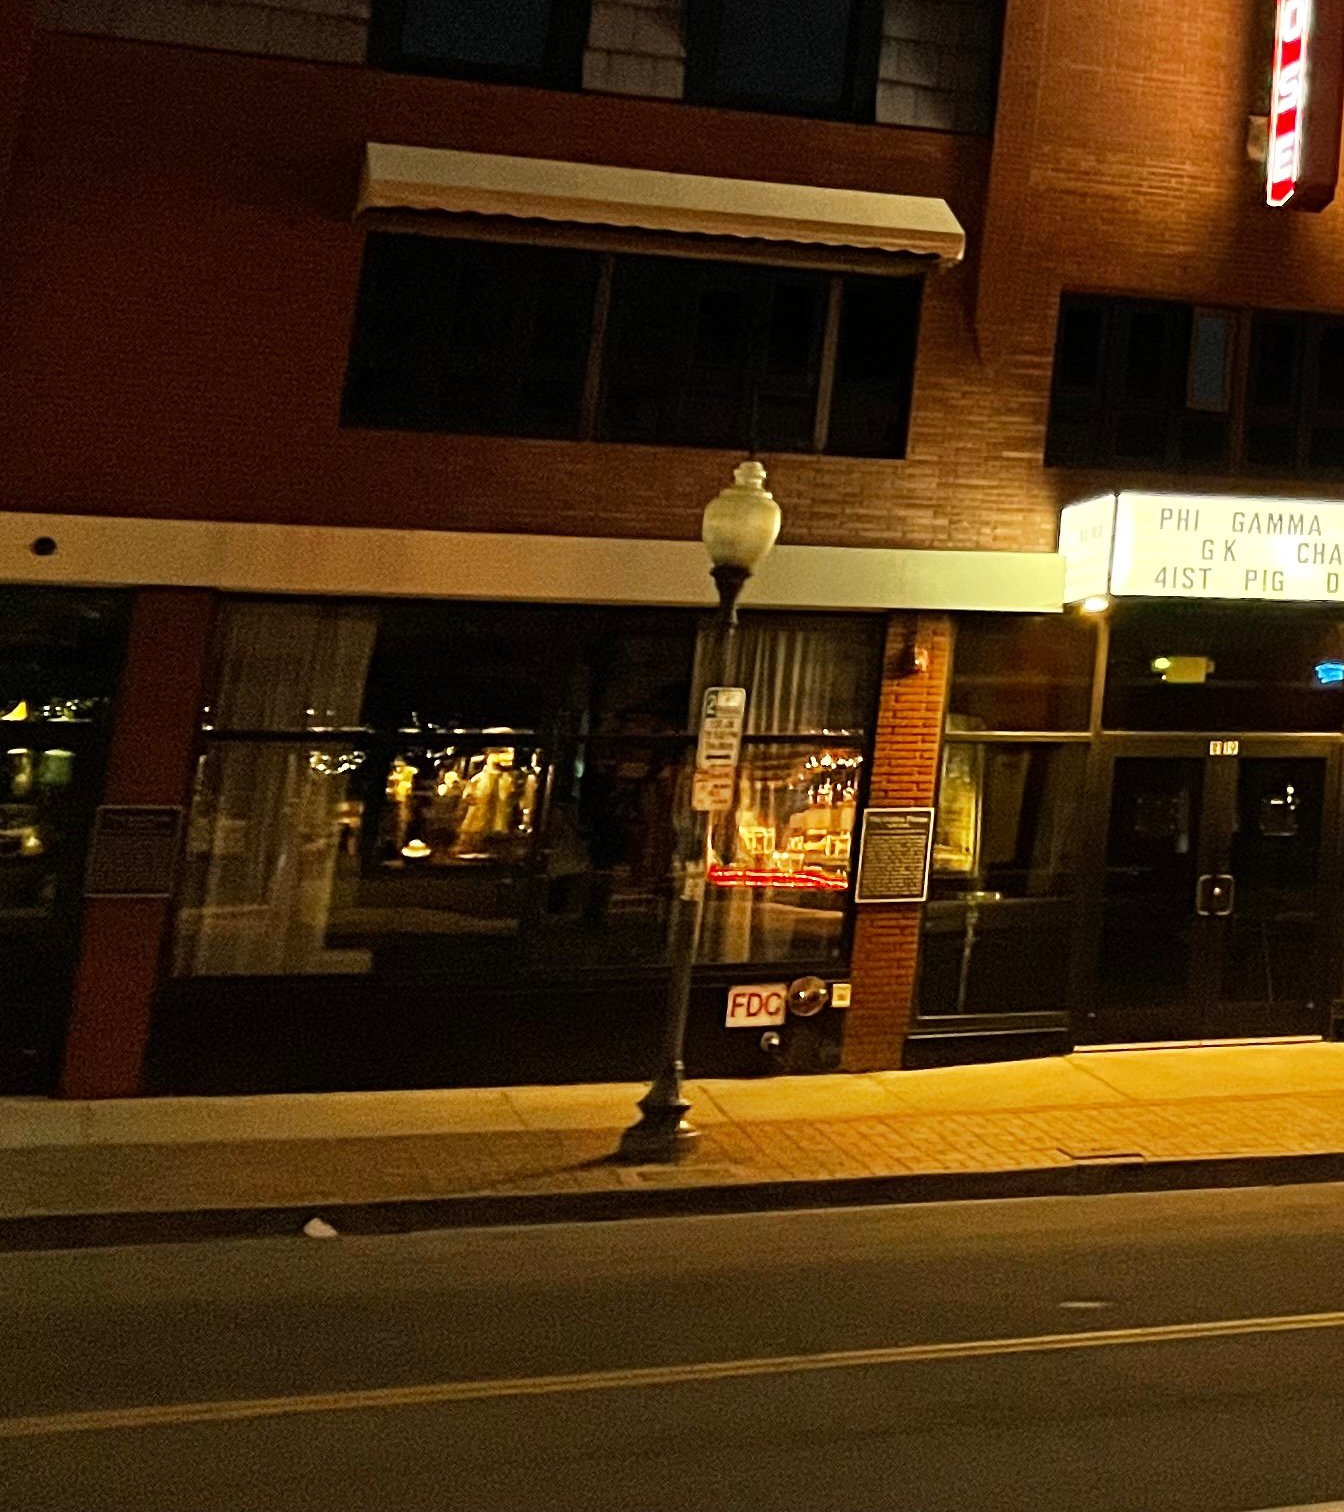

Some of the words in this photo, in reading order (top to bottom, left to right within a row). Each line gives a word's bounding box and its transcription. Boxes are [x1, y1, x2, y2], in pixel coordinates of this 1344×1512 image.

[1159, 507, 1200, 532] PHI
[1231, 511, 1322, 537] GAMMA
[1244, 568, 1285, 593] PIG
[729, 991, 783, 1018] FDC
